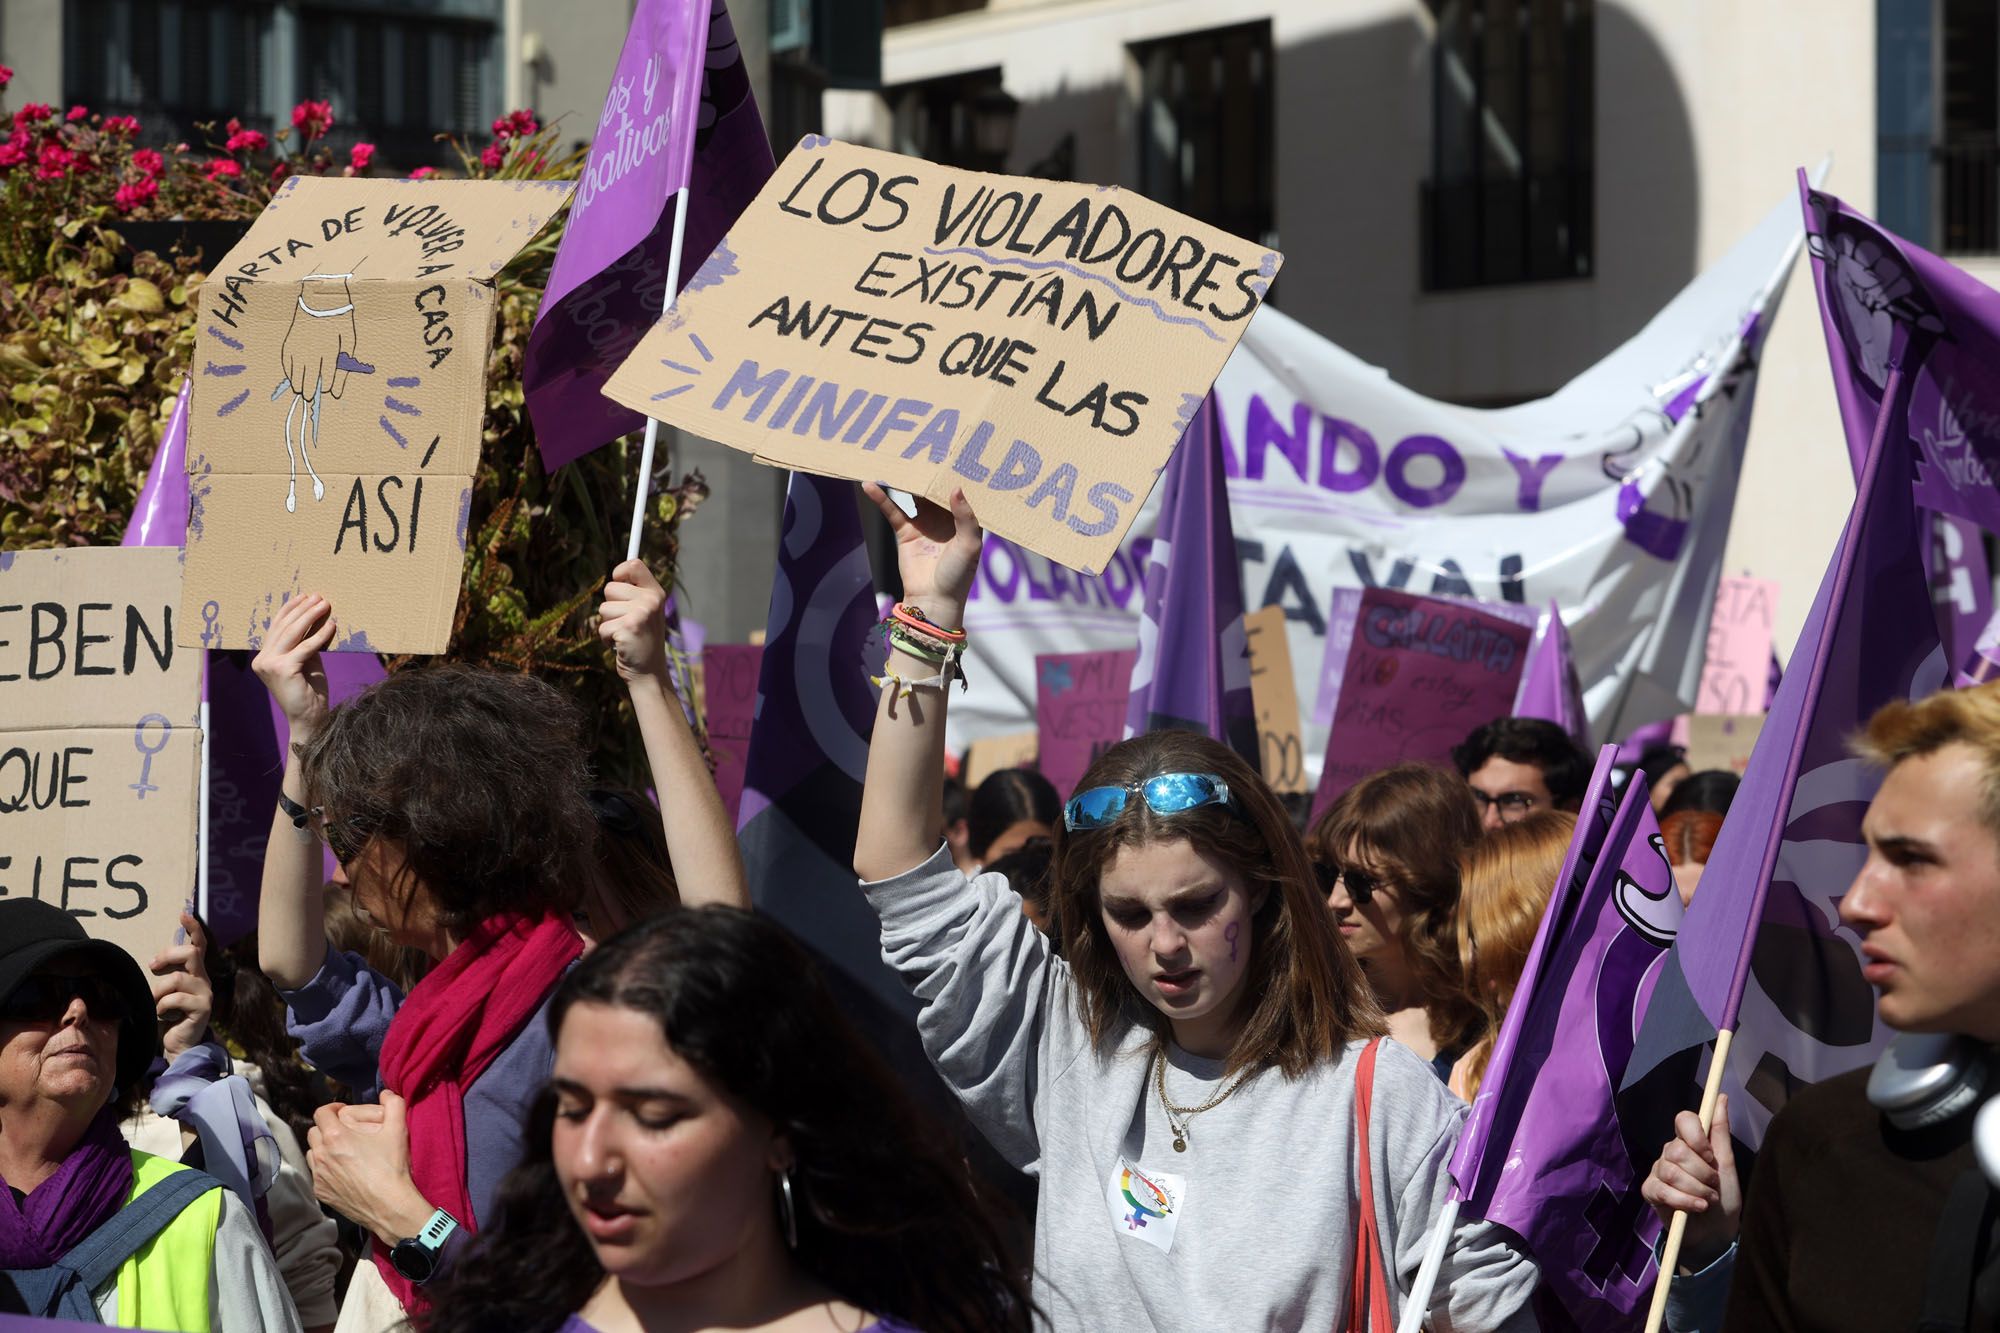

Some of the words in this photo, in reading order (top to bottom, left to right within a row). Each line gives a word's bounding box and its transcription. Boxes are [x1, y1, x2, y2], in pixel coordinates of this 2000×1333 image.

[321, 206, 366, 241] DE
[383, 203, 465, 259] VOLVER
[778, 158, 919, 233] LOS
[934, 182, 1261, 323] VIOLADORES
[212, 238, 314, 328] HARTA
[415, 263, 456, 278] A
[414, 284, 455, 369] CASA
[749, 295, 936, 365] ANTES
[938, 331, 1037, 387] QUE
[1036, 360, 1149, 438] LAS
[711, 357, 1134, 537] MINIFALDAS
[1499, 443, 1567, 514] Y
[334, 434, 442, 554] ASÍ
[0, 747, 94, 814] QUE
